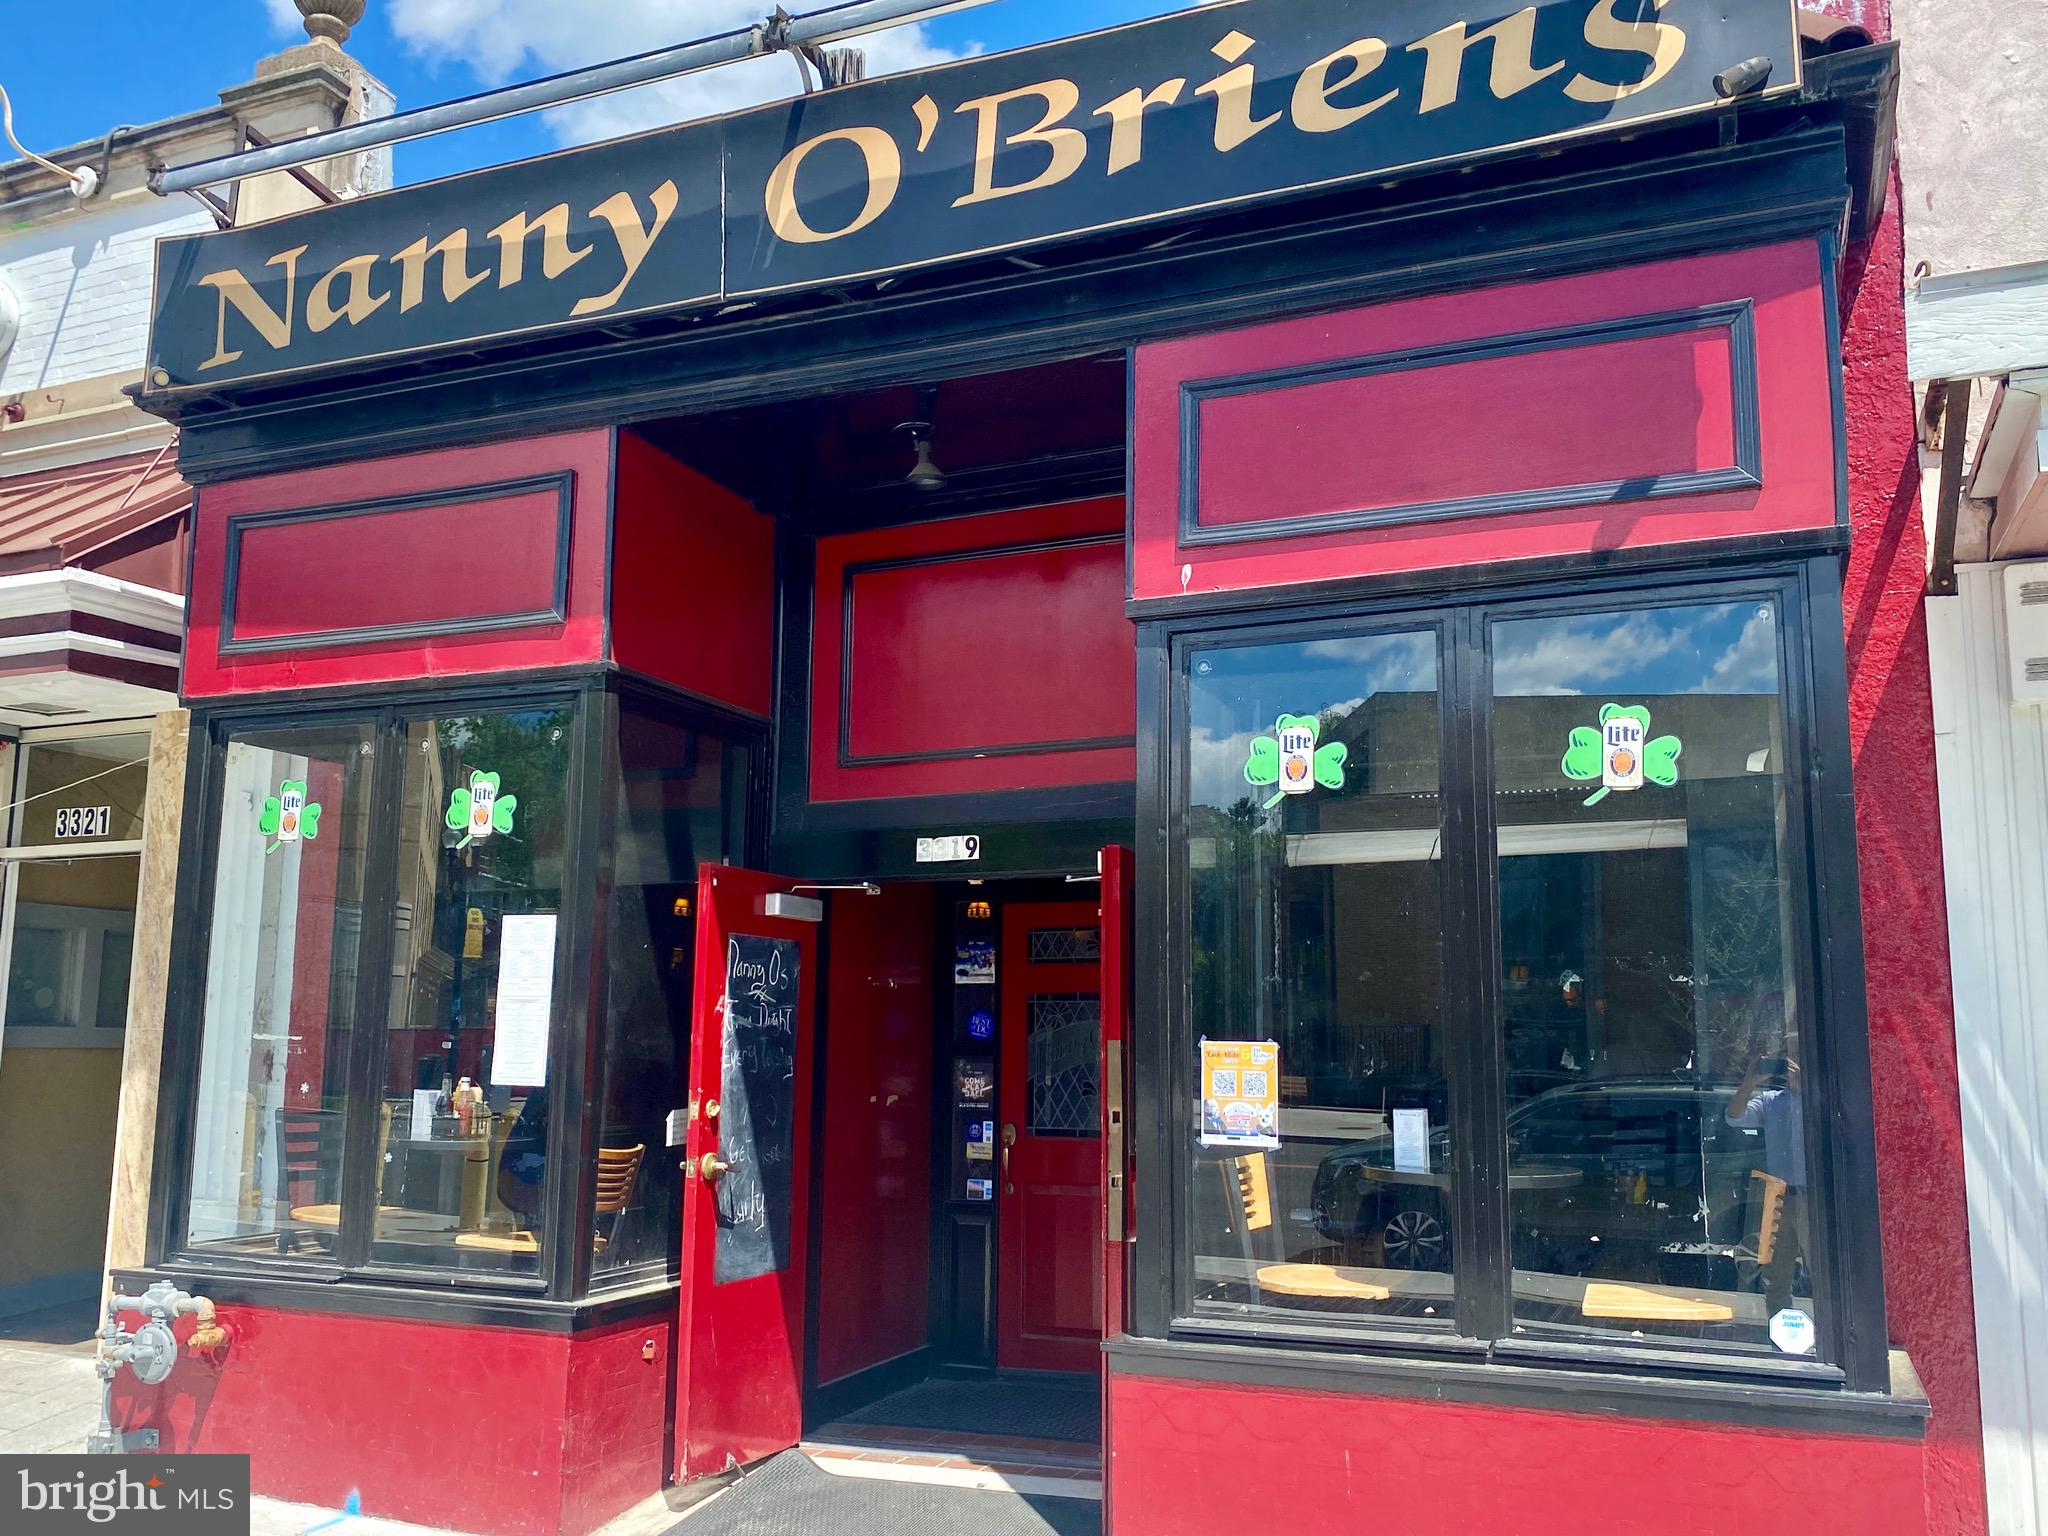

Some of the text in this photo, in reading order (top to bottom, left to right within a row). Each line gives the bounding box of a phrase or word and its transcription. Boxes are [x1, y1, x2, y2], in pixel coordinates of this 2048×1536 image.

[198, 0, 1687, 371] Nanny O'Briens
[1283, 735, 1311, 754] Lite
[1607, 726, 1640, 747] Lite
[283, 796, 301, 811] Lite
[474, 788, 493, 804] Lite
[57, 807, 108, 836] 3321
